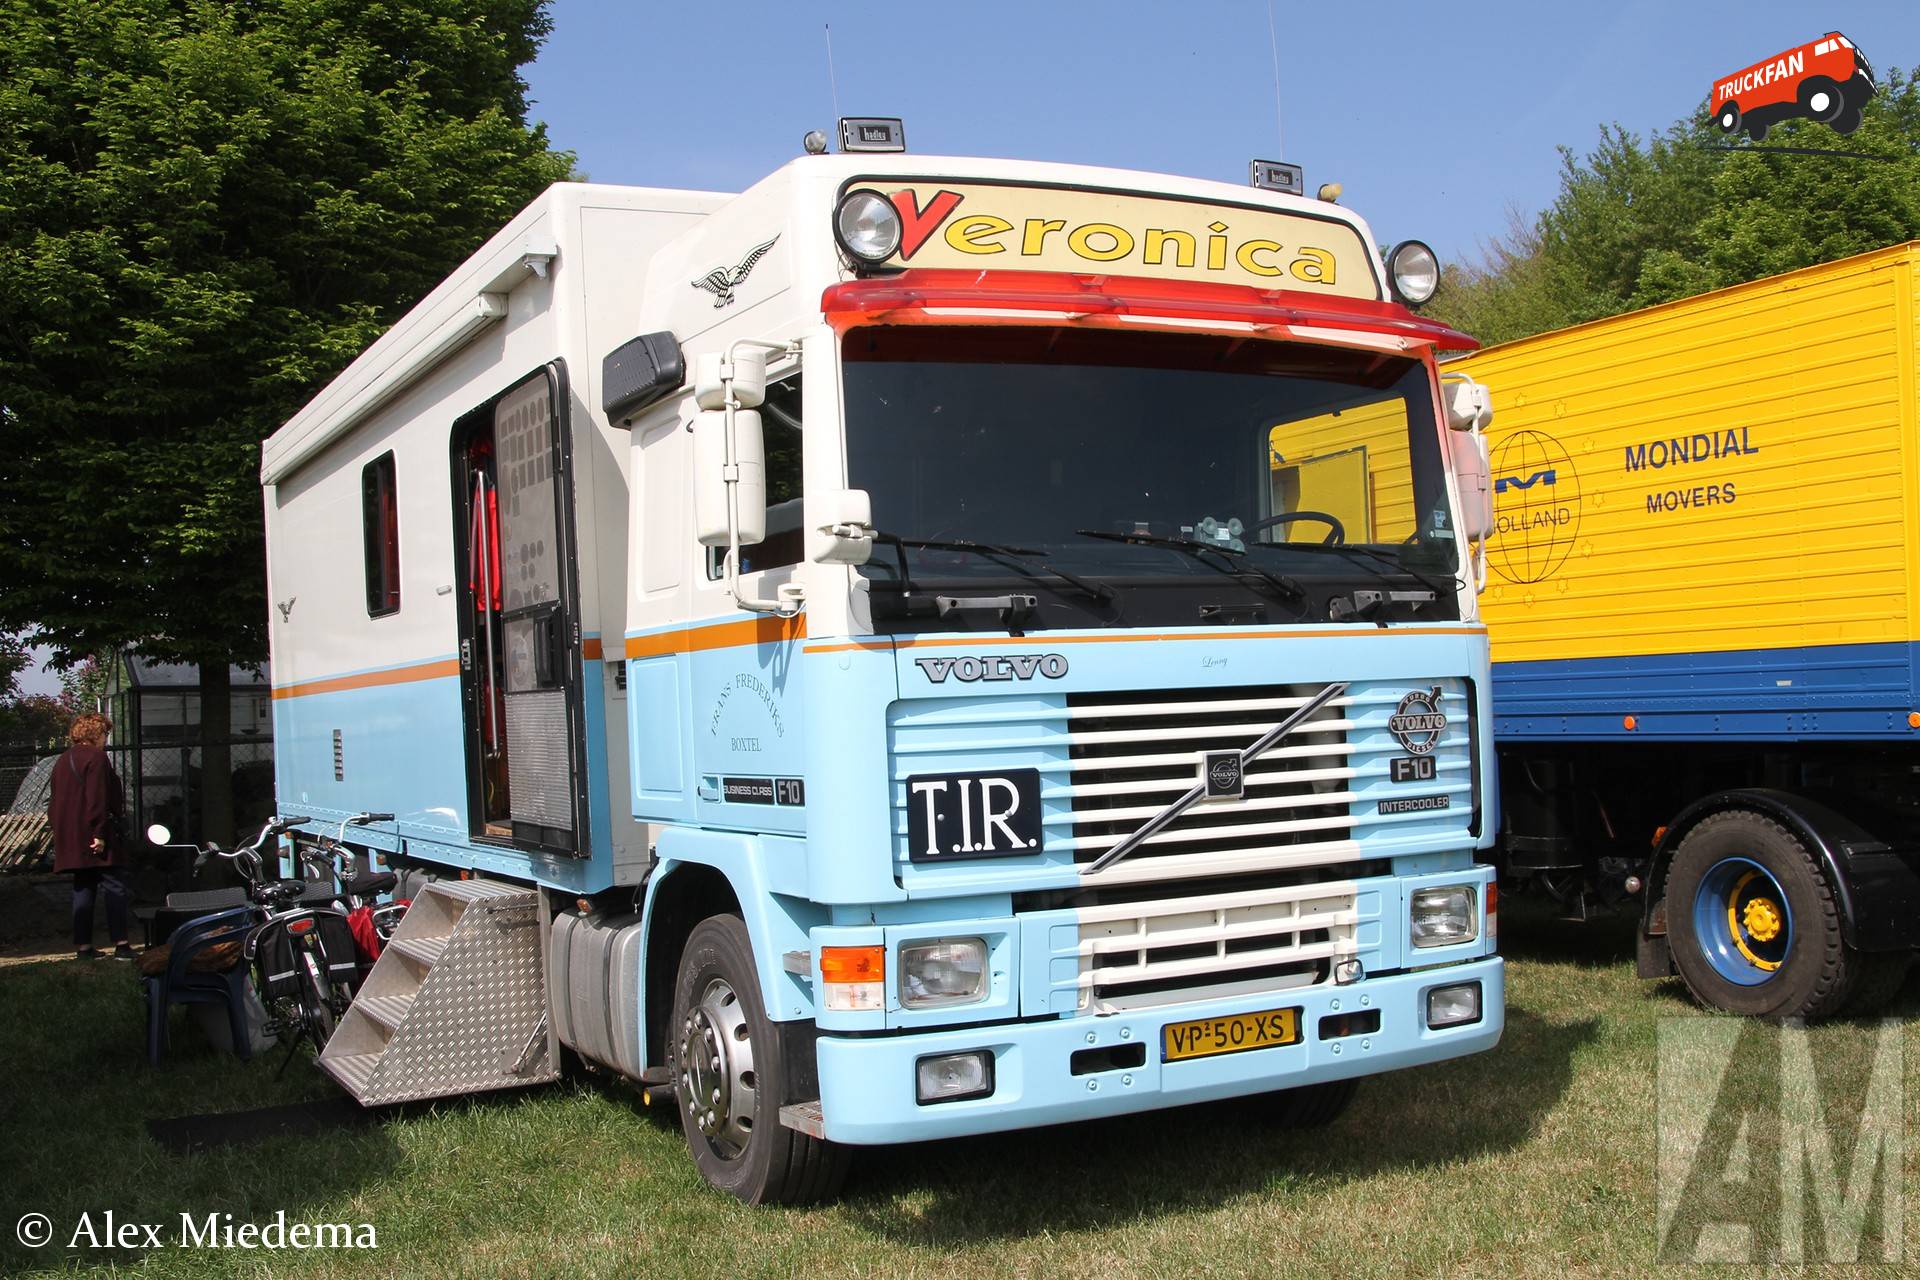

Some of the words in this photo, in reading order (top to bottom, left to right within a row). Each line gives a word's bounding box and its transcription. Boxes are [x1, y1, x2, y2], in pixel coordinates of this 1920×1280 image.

[887, 188, 1337, 285] Veronica
[1624, 426, 1759, 473] MONDIAL
[1645, 482, 1737, 514] MOVERS
[914, 653, 1070, 684] VOLVO
[1394, 714, 1446, 731] VOLVO
[731, 737, 762, 752] BOXTEL
[1397, 757, 1432, 781] F10
[723, 784, 752, 796] BUSINESS
[752, 786, 773, 797] CLASS
[777, 780, 801, 804] F10
[1380, 796, 1449, 813] INTERCOOLER
